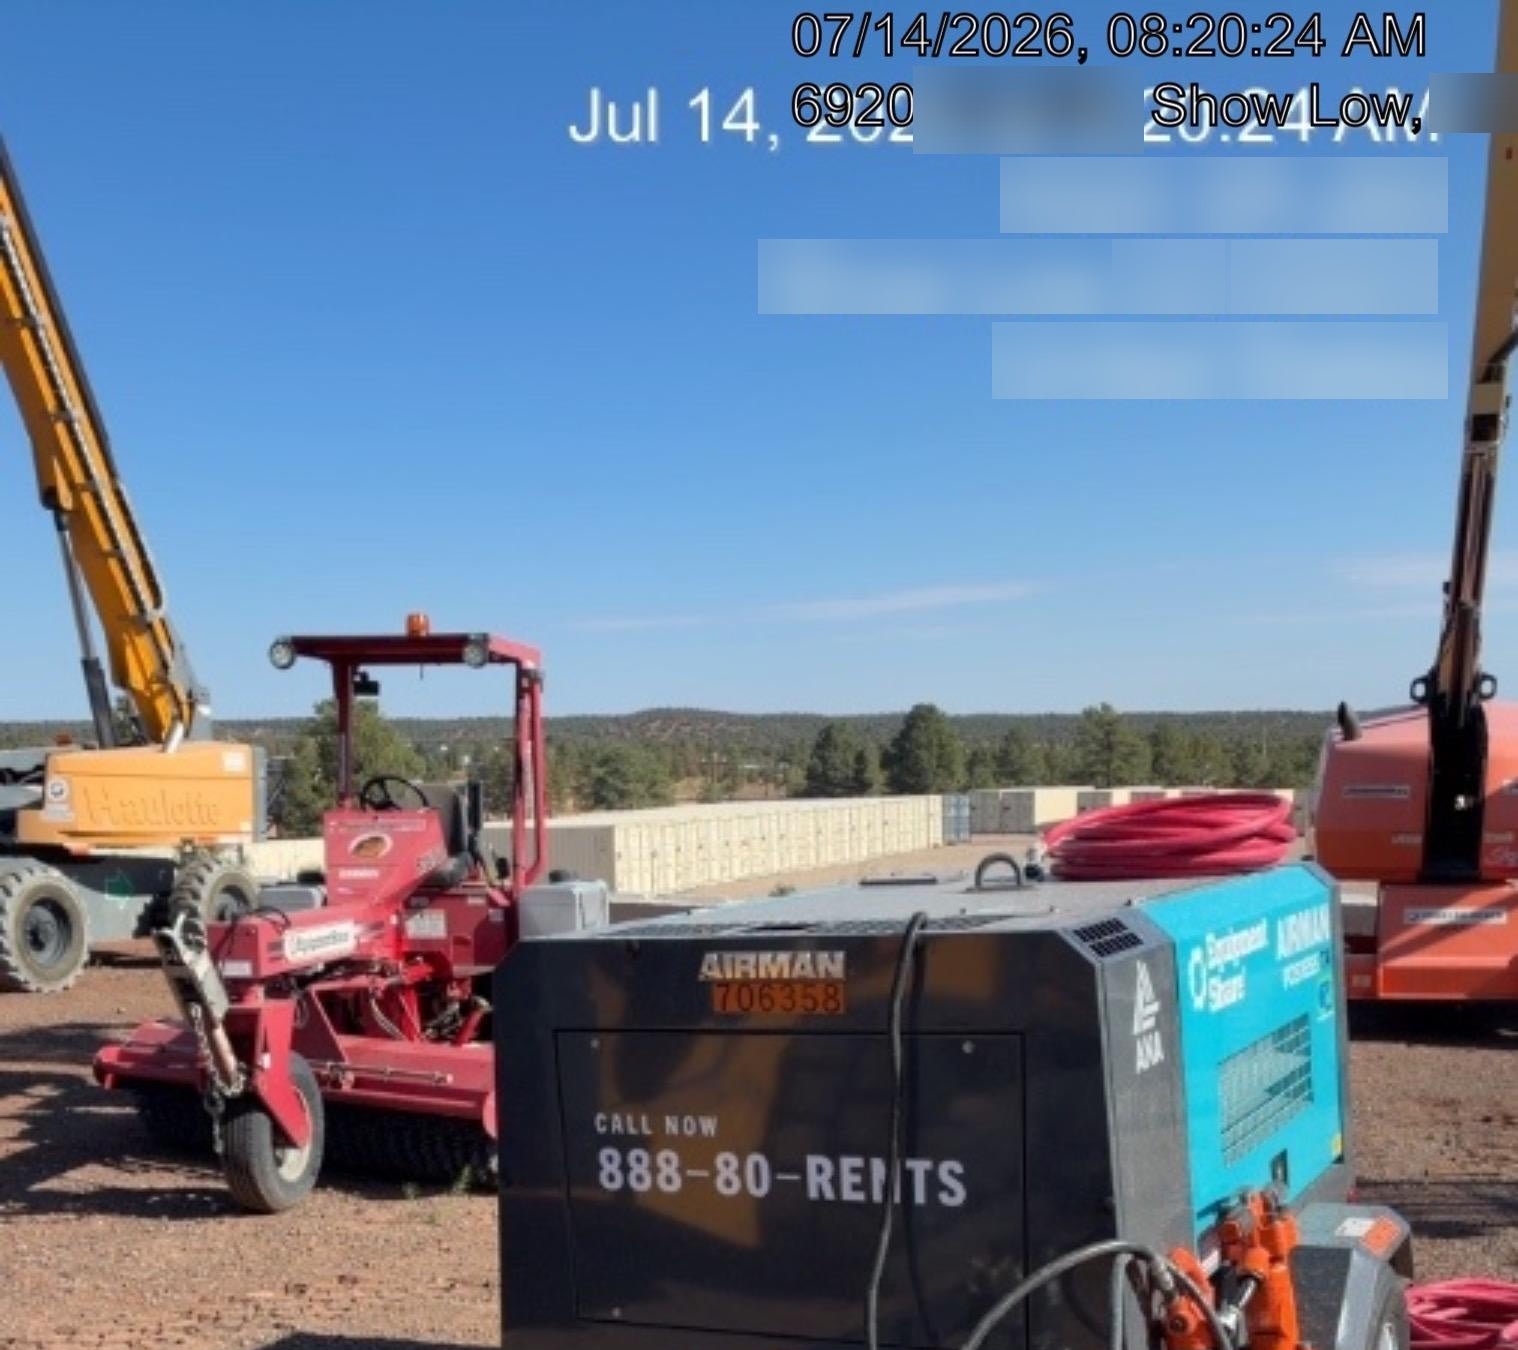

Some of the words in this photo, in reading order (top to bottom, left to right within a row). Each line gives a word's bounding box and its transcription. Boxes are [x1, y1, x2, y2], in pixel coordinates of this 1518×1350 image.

[699, 950, 845, 980] AIRMAN
[714, 982, 842, 1013] 706358
[595, 1113, 653, 1135] CALL
[665, 1114, 718, 1137] NOW
